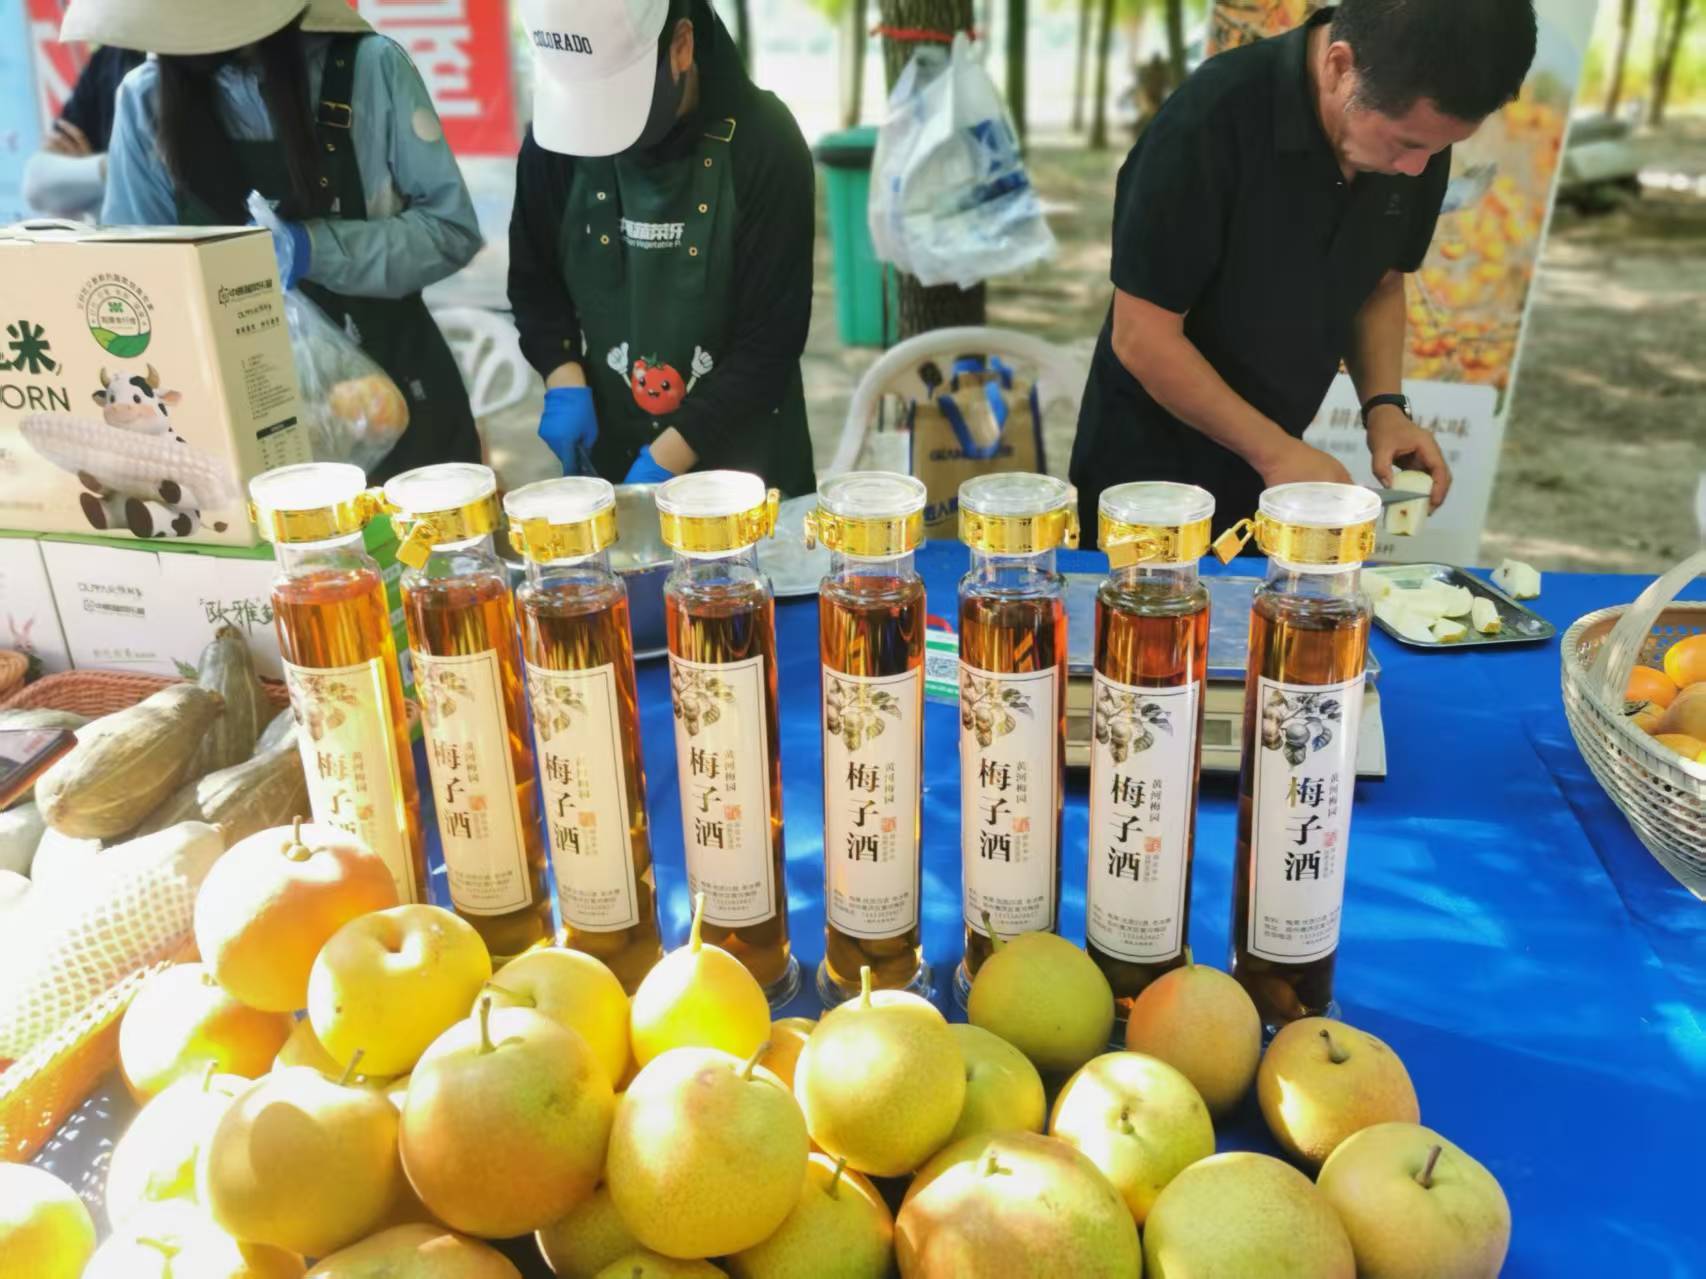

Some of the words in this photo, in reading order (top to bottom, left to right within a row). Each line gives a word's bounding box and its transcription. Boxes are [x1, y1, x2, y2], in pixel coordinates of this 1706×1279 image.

[533, 30, 593, 55] COLORADO
[0, 320, 57, 375] 米
[0, 384, 71, 412] ORN
[434, 738, 473, 839] 梅子酒
[545, 752, 581, 855] 梅子酒
[689, 746, 724, 849] 梅子酒
[845, 761, 880, 862] 梅子酒
[978, 757, 1012, 863] 梅子酒
[1108, 773, 1147, 882] 梅子酒
[1149, 779, 1162, 822] 黄河梅园
[1284, 776, 1325, 881] 梅子酒
